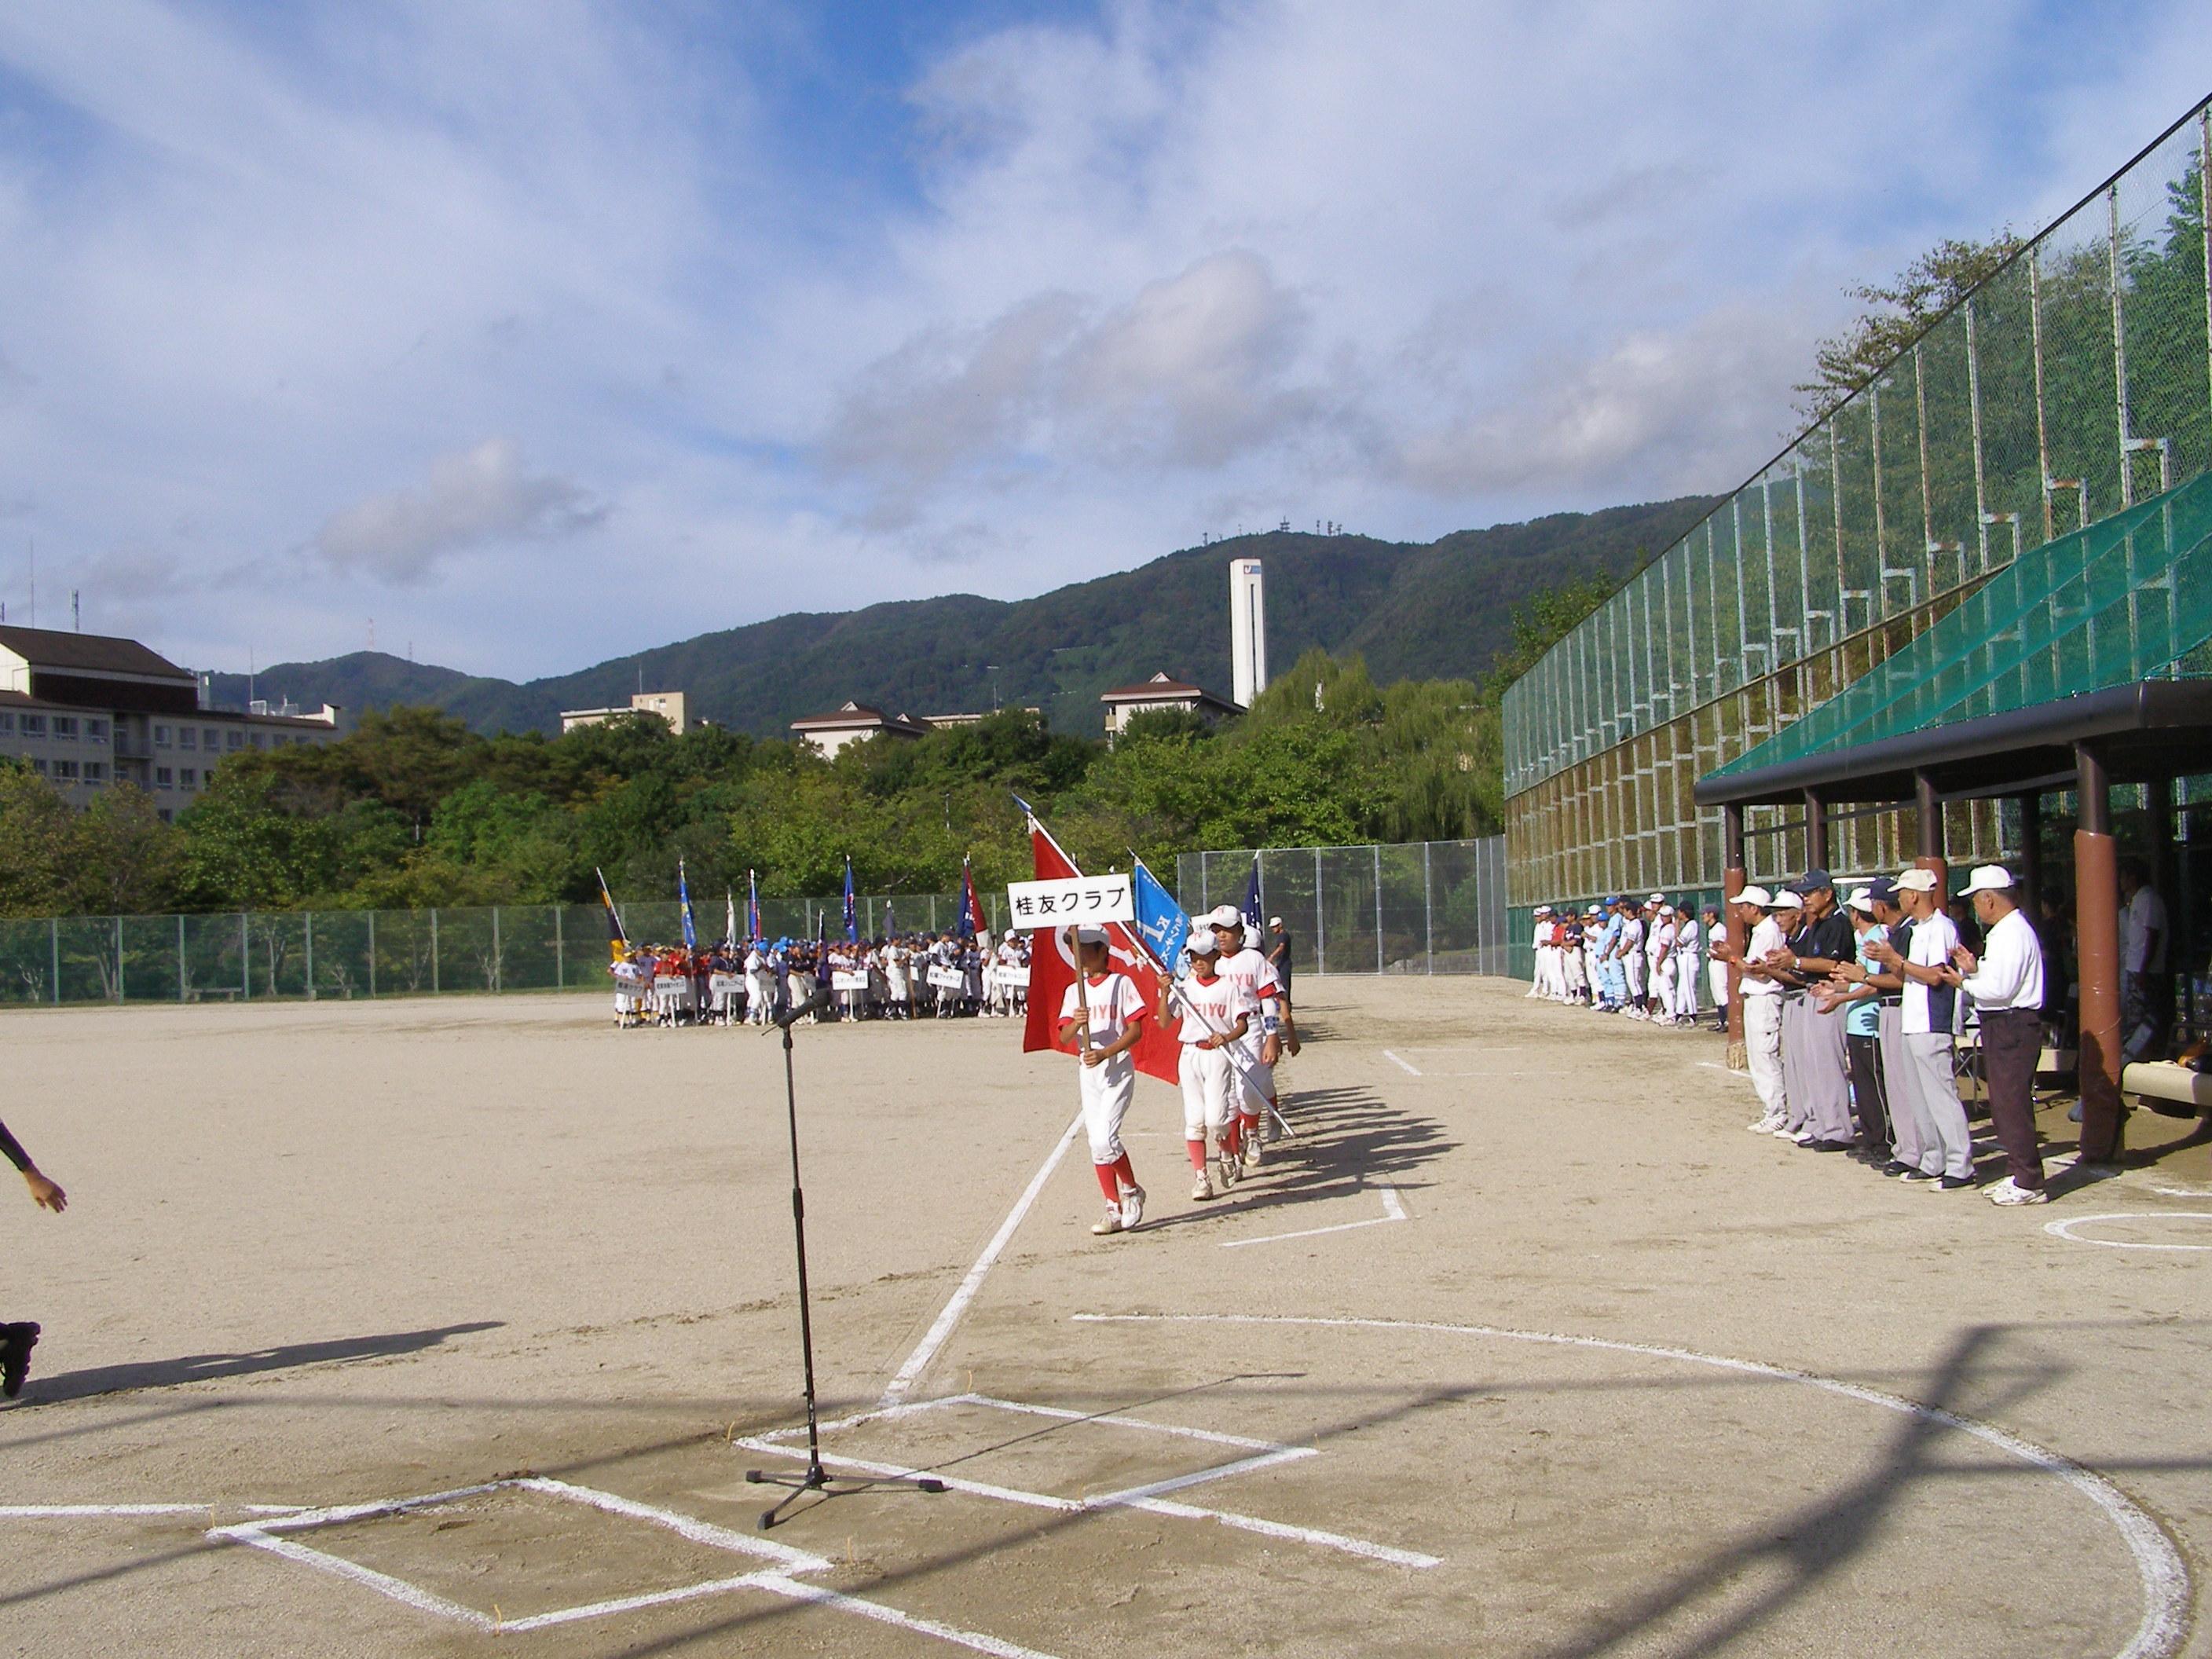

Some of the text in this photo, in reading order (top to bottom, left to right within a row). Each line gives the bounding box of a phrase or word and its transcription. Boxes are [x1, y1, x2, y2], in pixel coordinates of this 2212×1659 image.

[1016, 887, 1125, 915] 桂友クラブ
